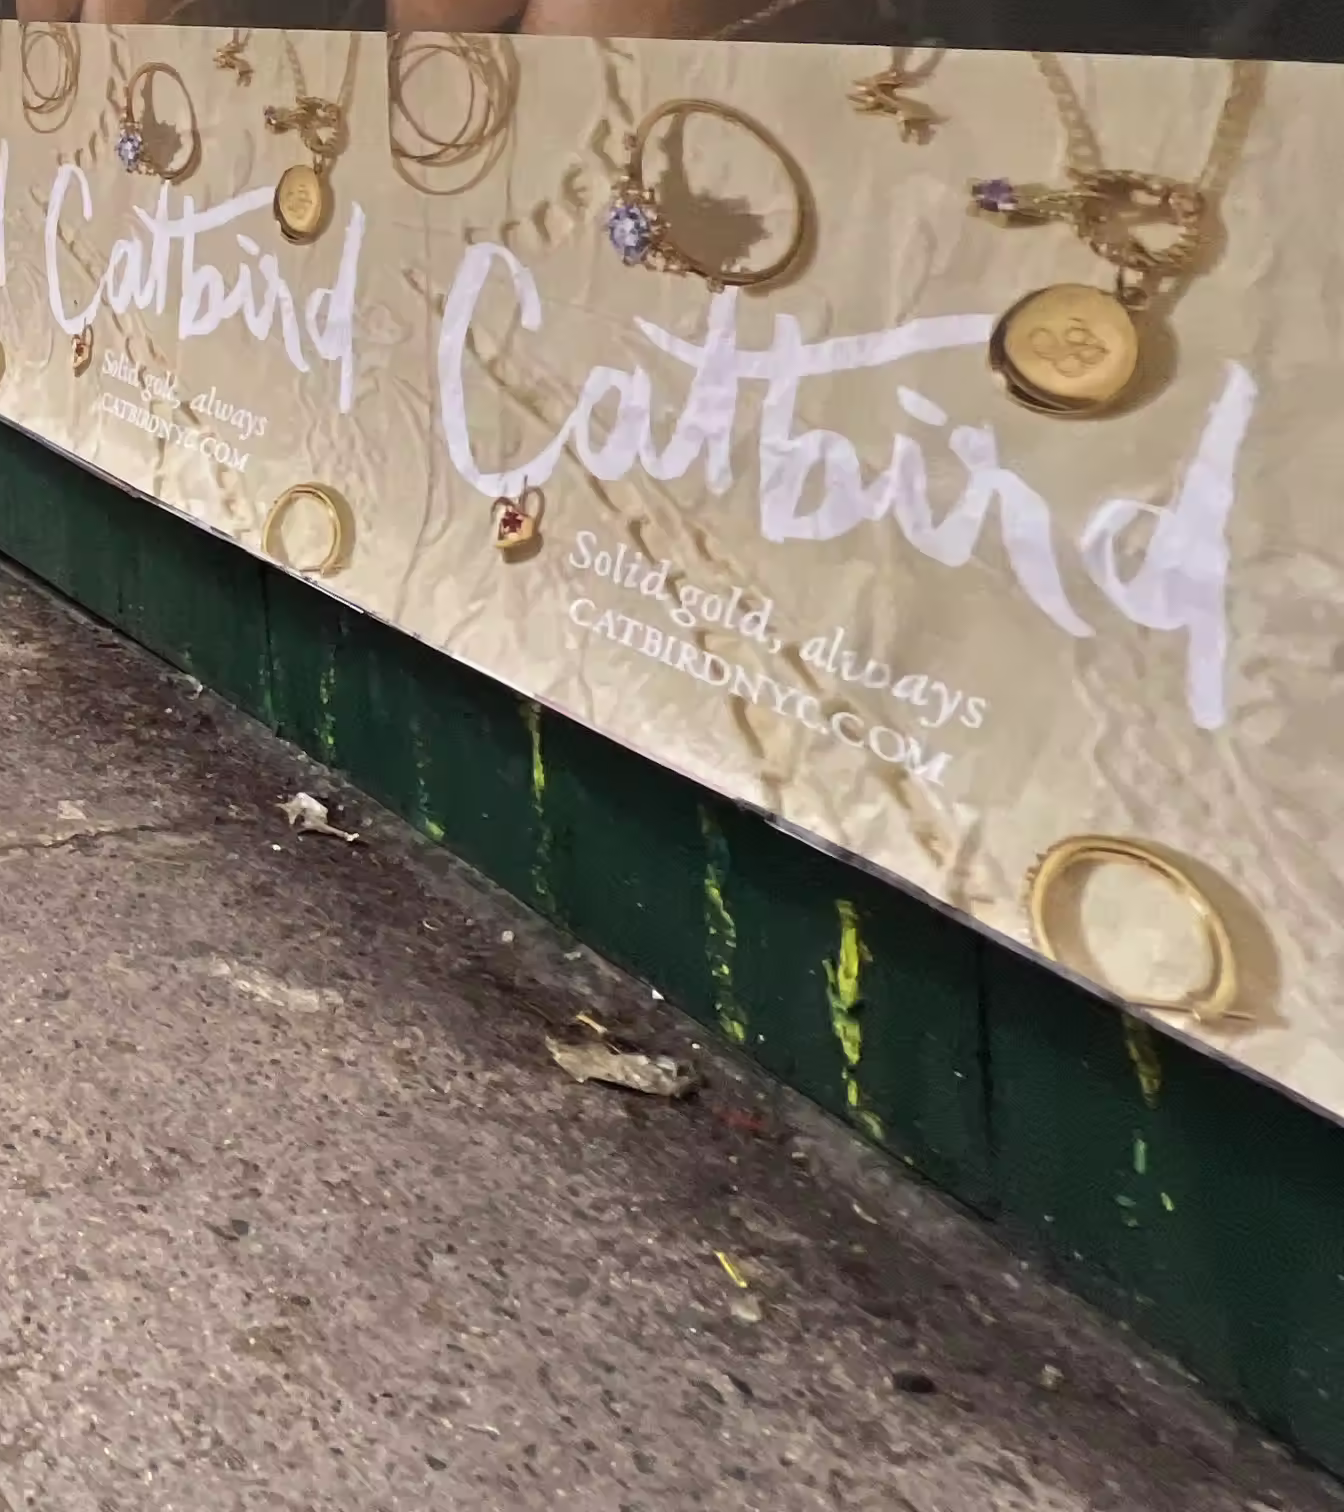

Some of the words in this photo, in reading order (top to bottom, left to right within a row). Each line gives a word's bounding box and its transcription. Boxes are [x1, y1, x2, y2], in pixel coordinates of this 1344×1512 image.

[45, 163, 366, 415] Catbird
[190, 385, 269, 442] always
[438, 242, 1258, 731] Catbird
[568, 529, 671, 602] Solid
[669, 585, 786, 655] gold,
[800, 626, 989, 730] always
[568, 597, 955, 787] CATBIRDNYC.COM
